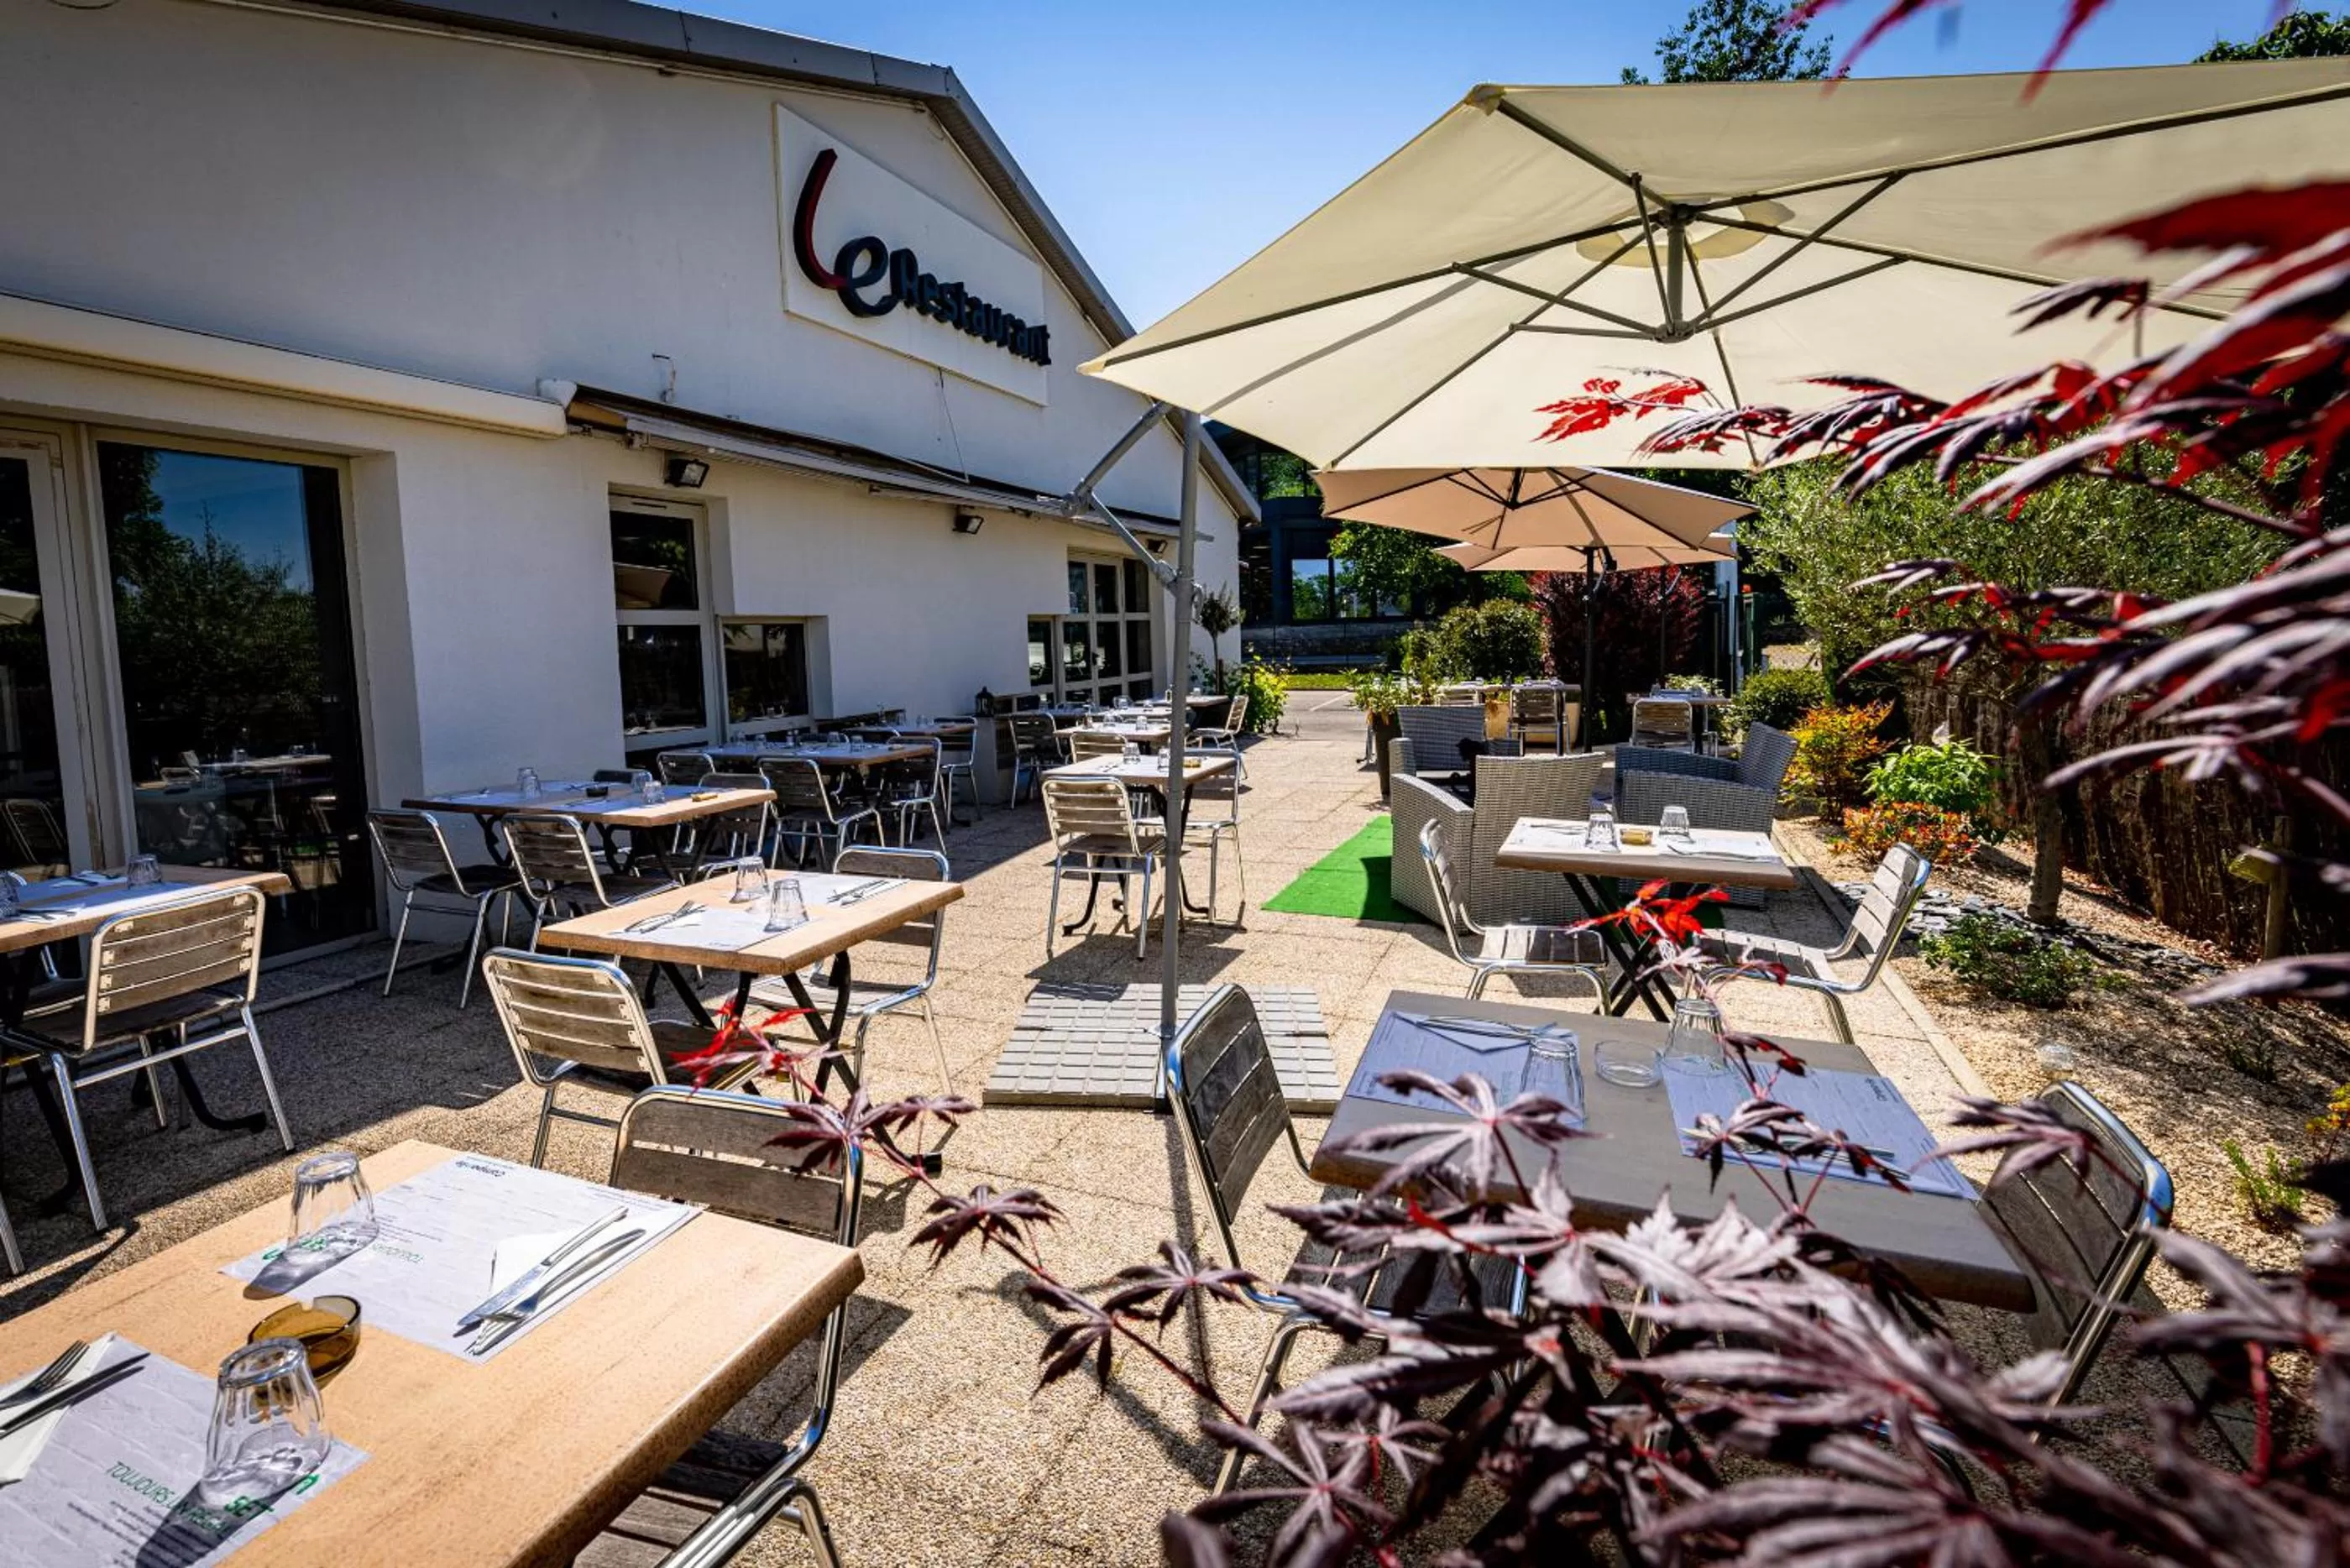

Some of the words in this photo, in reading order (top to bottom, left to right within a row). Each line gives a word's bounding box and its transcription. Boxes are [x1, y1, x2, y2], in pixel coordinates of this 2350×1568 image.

[793, 148, 898, 318] Le
[889, 248, 1051, 366] Restaurant
[106, 1461, 175, 1504] TOUJOURS
